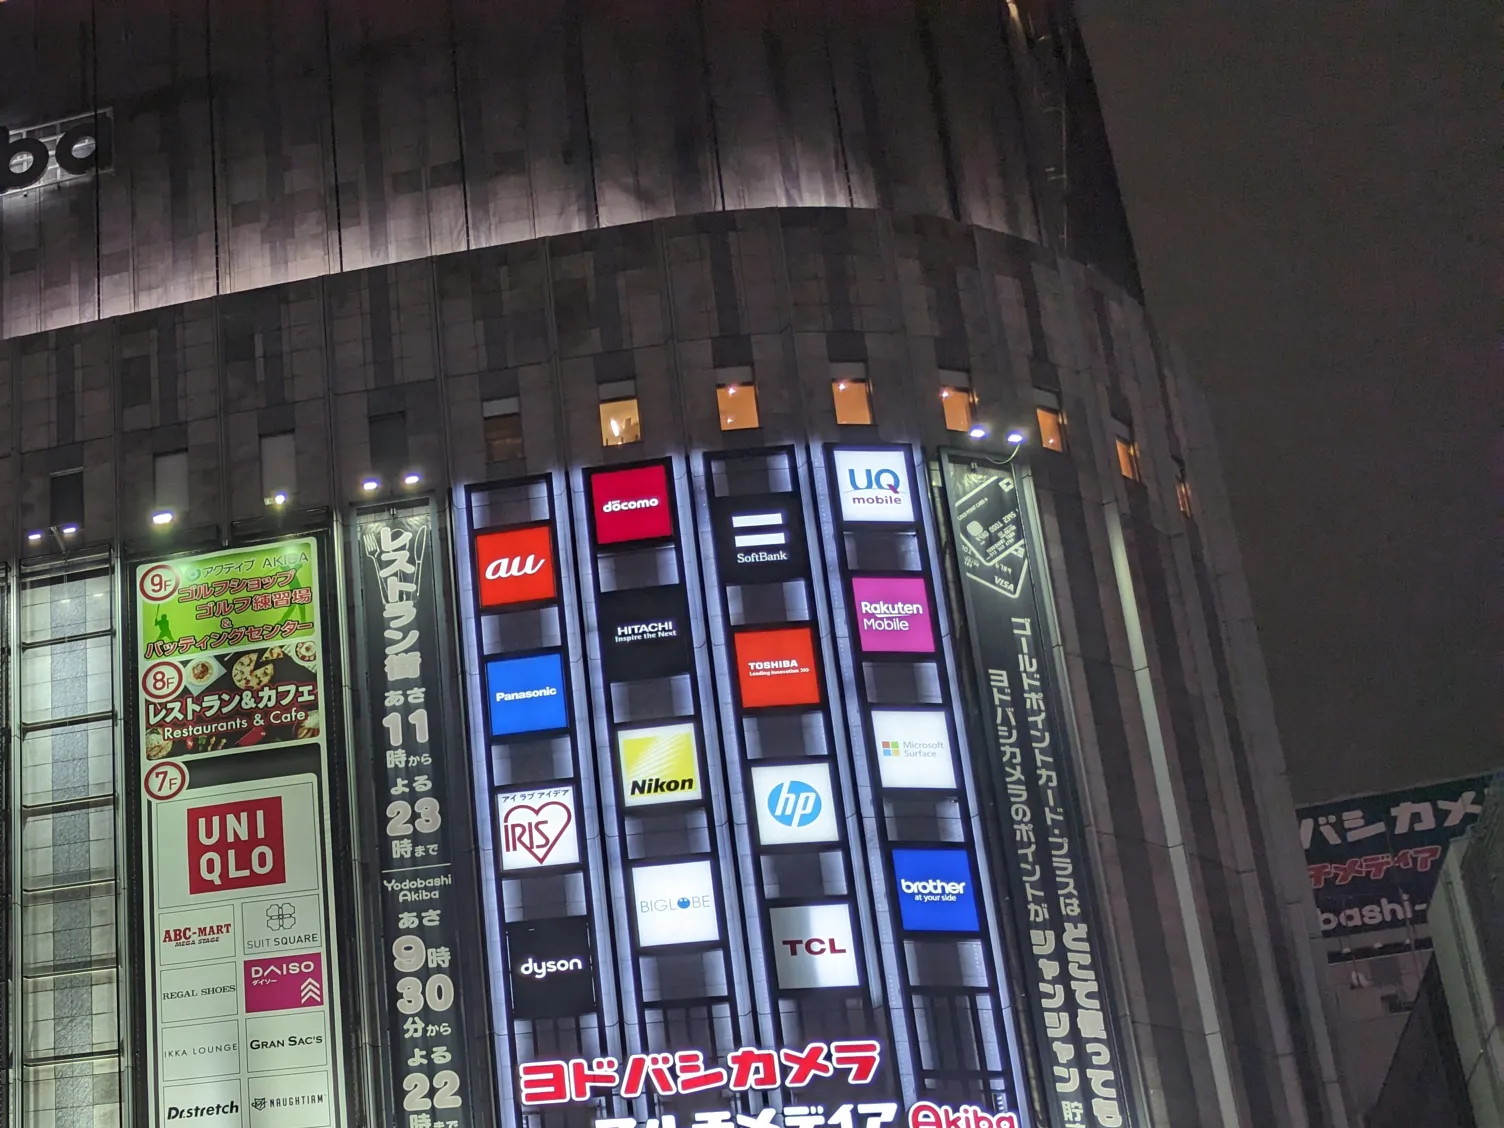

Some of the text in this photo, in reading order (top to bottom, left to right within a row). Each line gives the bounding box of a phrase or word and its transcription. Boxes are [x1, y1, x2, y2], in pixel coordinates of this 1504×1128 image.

[848, 467, 901, 494] UQ
[601, 495, 660, 514] docomo
[852, 494, 902, 505] mobile
[202, 551, 309, 579] アクティブ AKIBA
[484, 552, 546, 581] au
[736, 550, 788, 564] SoftBank
[149, 572, 172, 593] 9F
[177, 568, 297, 603] ゴルフショップ
[195, 587, 312, 620] ゴルフ練習場
[378, 526, 422, 681] レストラン街
[861, 600, 923, 617] Rakuten
[616, 621, 674, 636] HITACHI
[863, 617, 910, 631] Mobile
[144, 620, 314, 660] バッティングセンター
[748, 659, 799, 671] TOSHIBA
[152, 670, 175, 691] 8F
[148, 683, 316, 725] レストラン&カフェ
[384, 686, 426, 707] あさ
[495, 686, 558, 702] Panasonic
[163, 707, 306, 741] Restaurants & Cafe
[382, 708, 429, 747] 11
[903, 740, 945, 751] Microsoft
[903, 748, 937, 758] Surface
[386, 748, 433, 769] 時から
[155, 770, 178, 793] 7F
[390, 775, 433, 796] よる
[629, 776, 695, 797] Nikon
[386, 796, 442, 837] 23
[775, 787, 812, 826] hp
[198, 809, 265, 847] UNI
[392, 837, 439, 860] 時まで
[199, 846, 274, 885] QLO
[383, 874, 453, 892] Yodobashi
[900, 878, 966, 896] brother
[398, 889, 440, 902] Akiba
[398, 908, 441, 930] あさ
[162, 923, 232, 943] ABC-MART
[247, 932, 319, 950] SUIT SQUARE
[391, 934, 452, 973] 9時
[782, 938, 847, 956] TCL
[250, 961, 315, 979] DAISO
[520, 955, 584, 979] dyson
[162, 984, 236, 1001] REGAL SHOES
[396, 972, 455, 1015] 30
[403, 1015, 452, 1039] 分から
[164, 1042, 238, 1059] IKKA LOUNGE
[407, 1045, 452, 1067] よる
[520, 1040, 881, 1105] ヨドバシカメラ
[402, 1069, 463, 1113] 22
[167, 1100, 240, 1121] Dr.stretch
